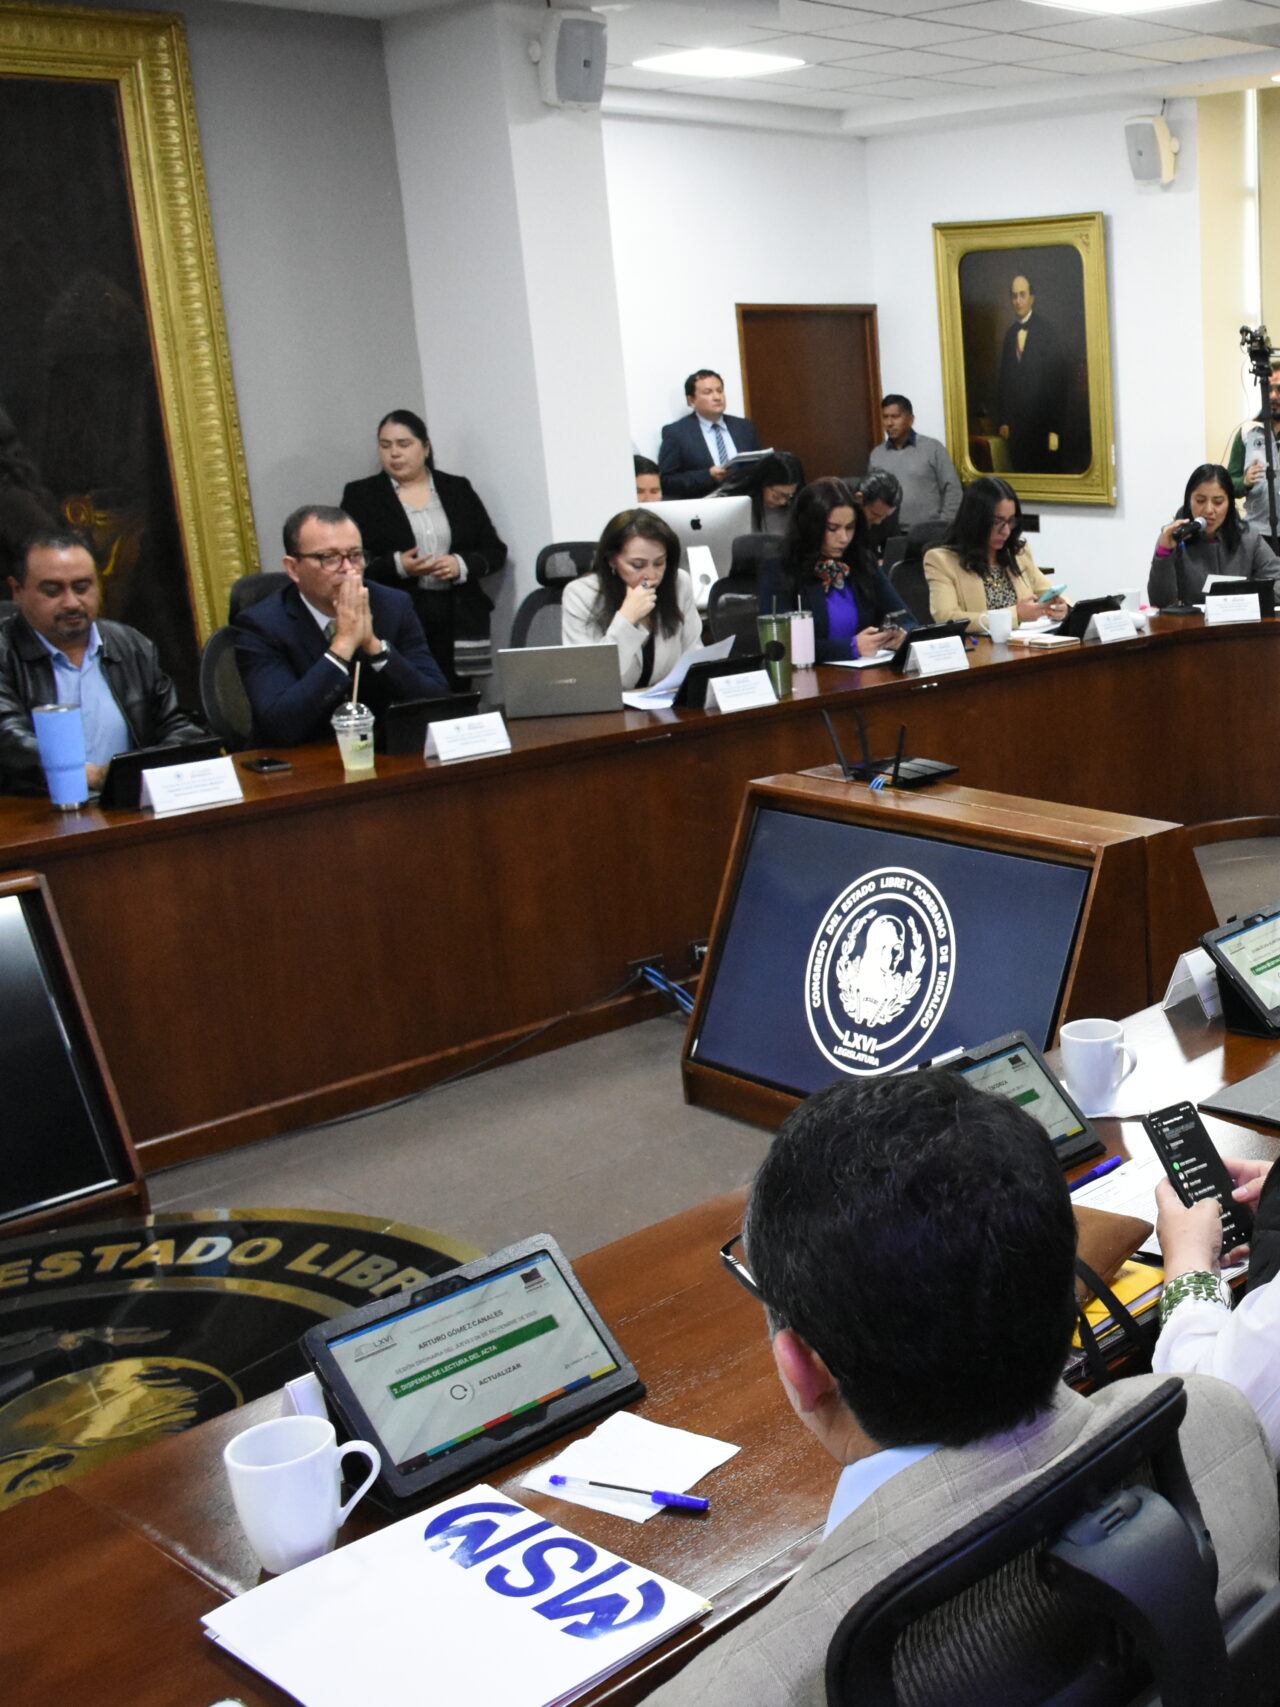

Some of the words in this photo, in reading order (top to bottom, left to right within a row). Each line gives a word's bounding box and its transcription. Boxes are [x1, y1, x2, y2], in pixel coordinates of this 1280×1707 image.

[880, 877, 906, 889] LIBRE
[904, 880, 914, 891] Y
[841, 881, 876, 913] ESTADO
[913, 885, 947, 939] SOBERANO
[826, 914, 842, 936] DEL
[940, 944, 948, 964] DE
[812, 940, 828, 1008] CONGRESO
[920, 971, 948, 1029] HIDALGO
[842, 1030, 878, 1054] LXVI
[833, 1045, 880, 1067] LEGISLATURA
[0, 1236, 283, 1289] ESTADO
[285, 1242, 432, 1299] LIBR
[373, 1334, 393, 1349] LXVI
[418, 1333, 446, 1351] ARTURO
[446, 1321, 471, 1338] GÓMEZ
[472, 1308, 503, 1328] CANALES
[401, 1373, 432, 1392] DISPENSA
[431, 1368, 442, 1379] DE
[442, 1357, 468, 1374] LECTURA
[468, 1351, 481, 1362] DEL
[481, 1344, 497, 1355] ACTA
[478, 1362, 522, 1387] ACTUALIZAR
